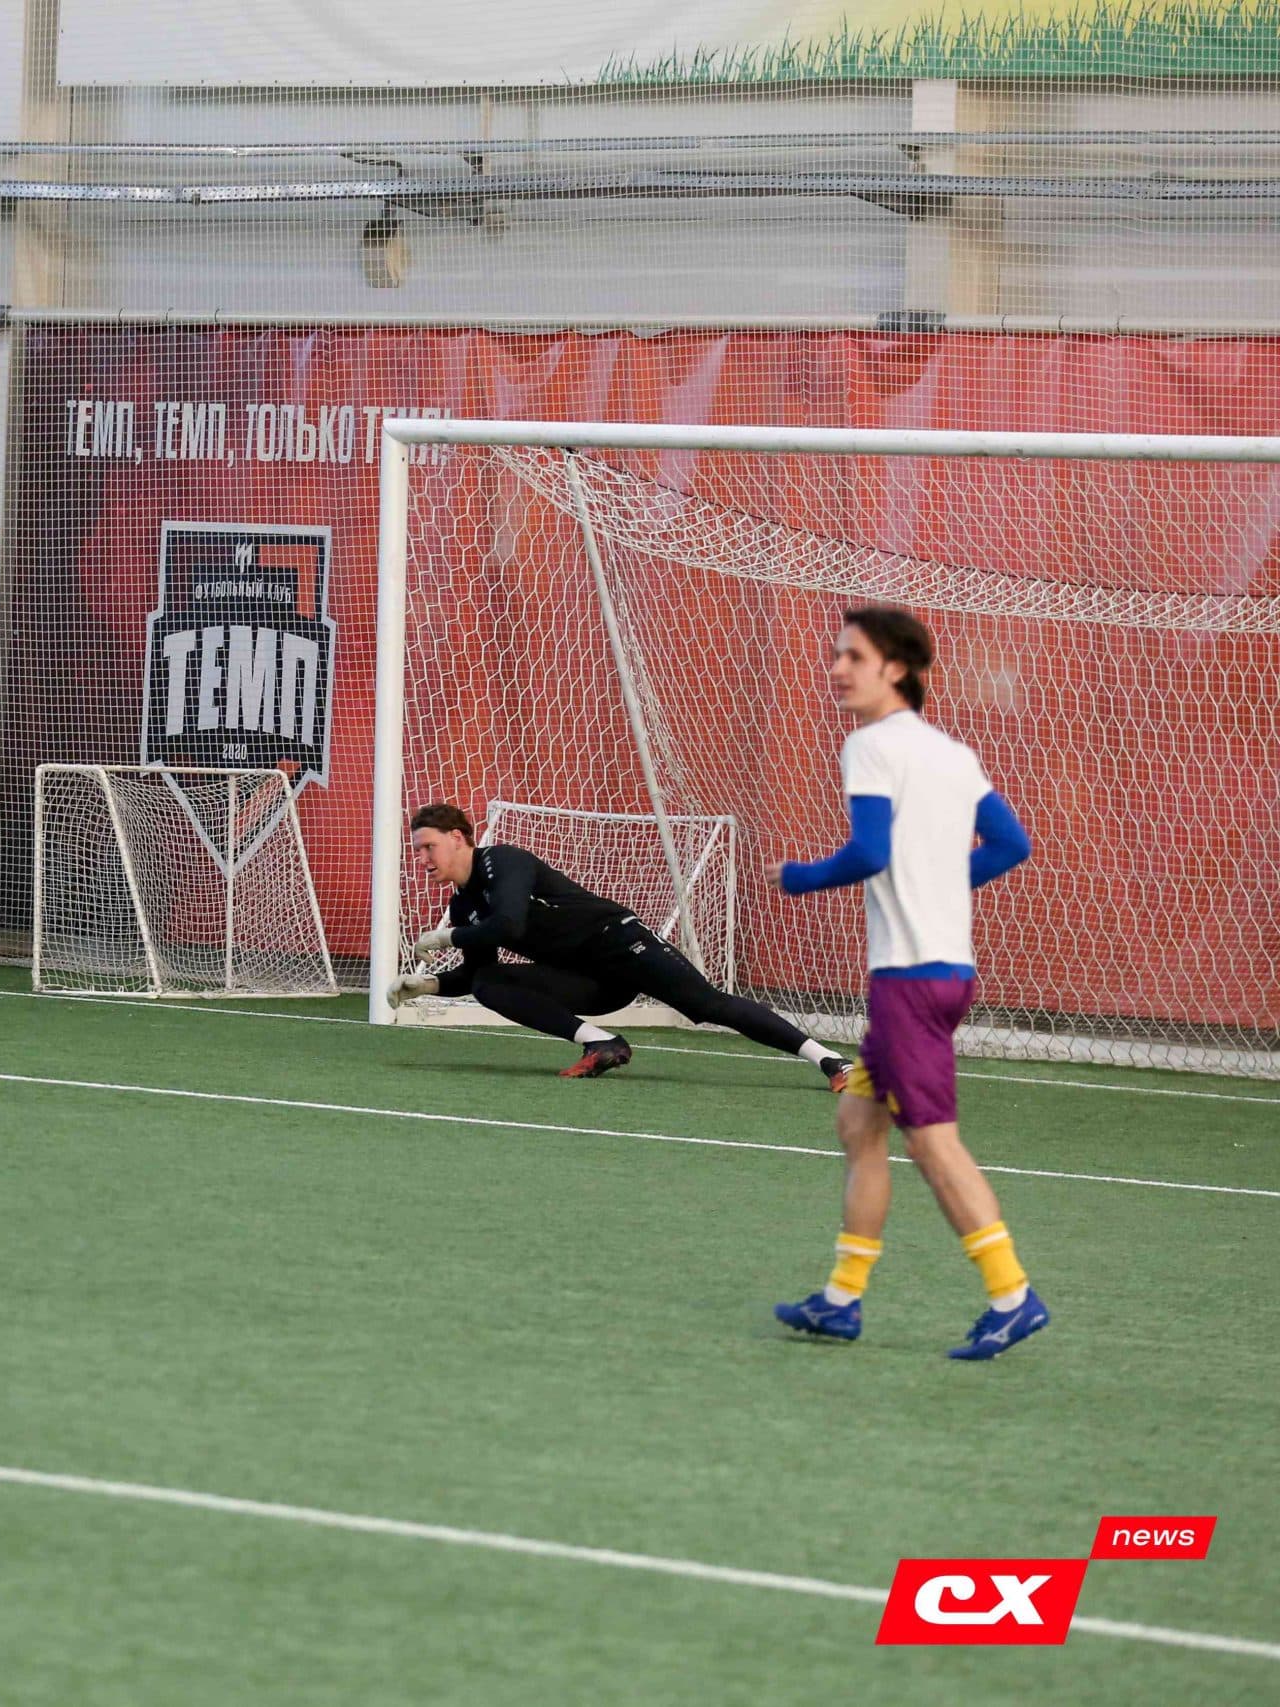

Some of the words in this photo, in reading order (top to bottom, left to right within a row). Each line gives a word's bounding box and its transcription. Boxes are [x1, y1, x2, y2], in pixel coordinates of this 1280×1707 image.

[66, 400, 141, 464] ТЕМП,
[154, 402, 233, 467] ТЕМП,
[244, 403, 354, 463] ТОЛЬКО
[195, 577, 264, 600] ФУТБОЛЬНЫЙ
[163, 625, 318, 747] ТЕМП
[222, 743, 248, 760] 2020
